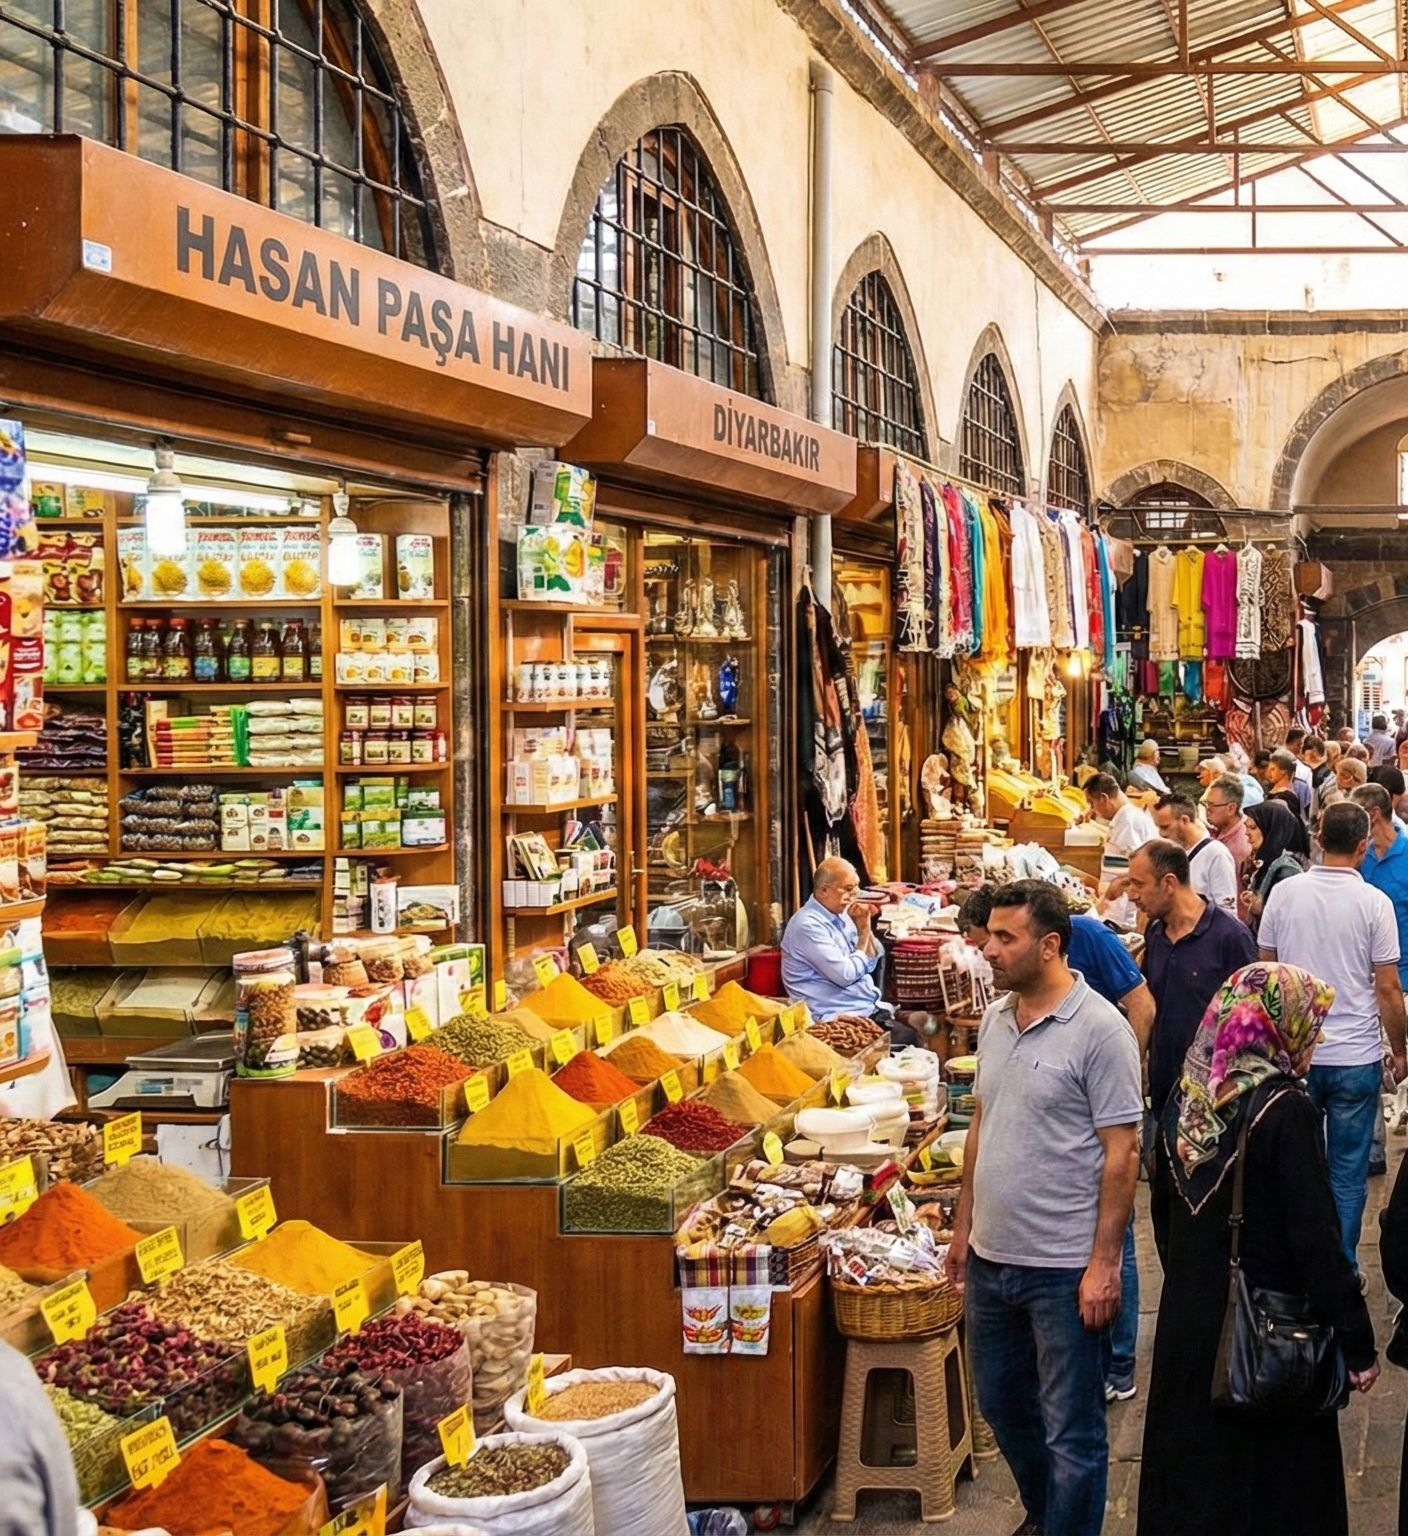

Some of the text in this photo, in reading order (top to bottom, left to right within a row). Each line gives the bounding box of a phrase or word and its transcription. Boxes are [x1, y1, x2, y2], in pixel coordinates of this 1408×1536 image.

[176, 206, 570, 392] HASAN PAŞA HANI
[713, 398, 820, 472] DİYARBAKIR
